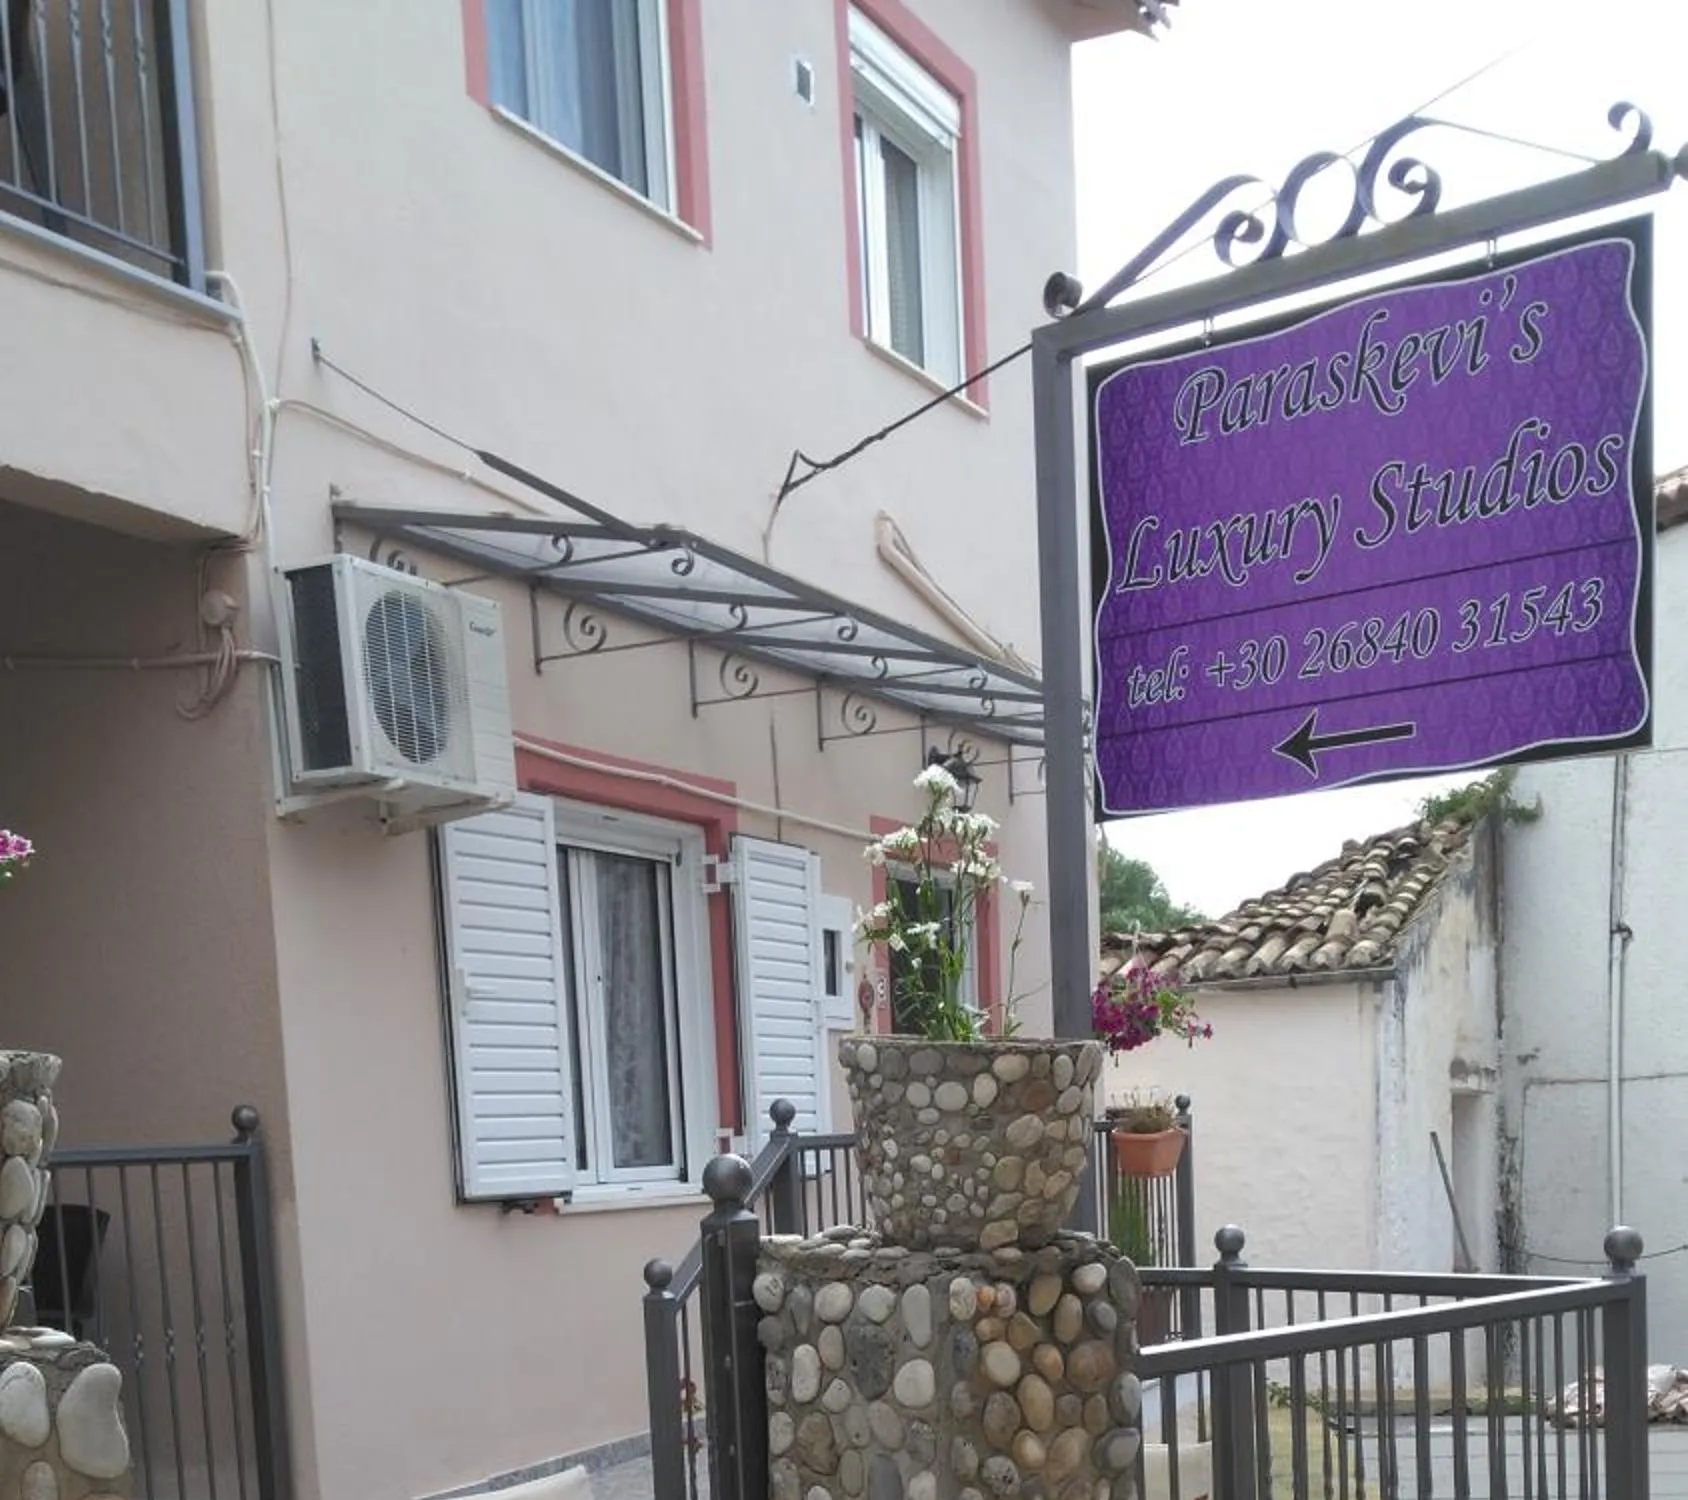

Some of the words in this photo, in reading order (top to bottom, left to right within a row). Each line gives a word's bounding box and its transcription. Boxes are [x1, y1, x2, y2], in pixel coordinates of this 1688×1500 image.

[1175, 276, 1547, 446] Paraskevi's
[1116, 495, 1341, 593] Luxury
[1356, 418, 1623, 549] Studios
[1128, 646, 1189, 708] tel:
[1206, 635, 1287, 692] +30
[1300, 606, 1439, 680] 26840
[1454, 577, 1605, 652] 31543
